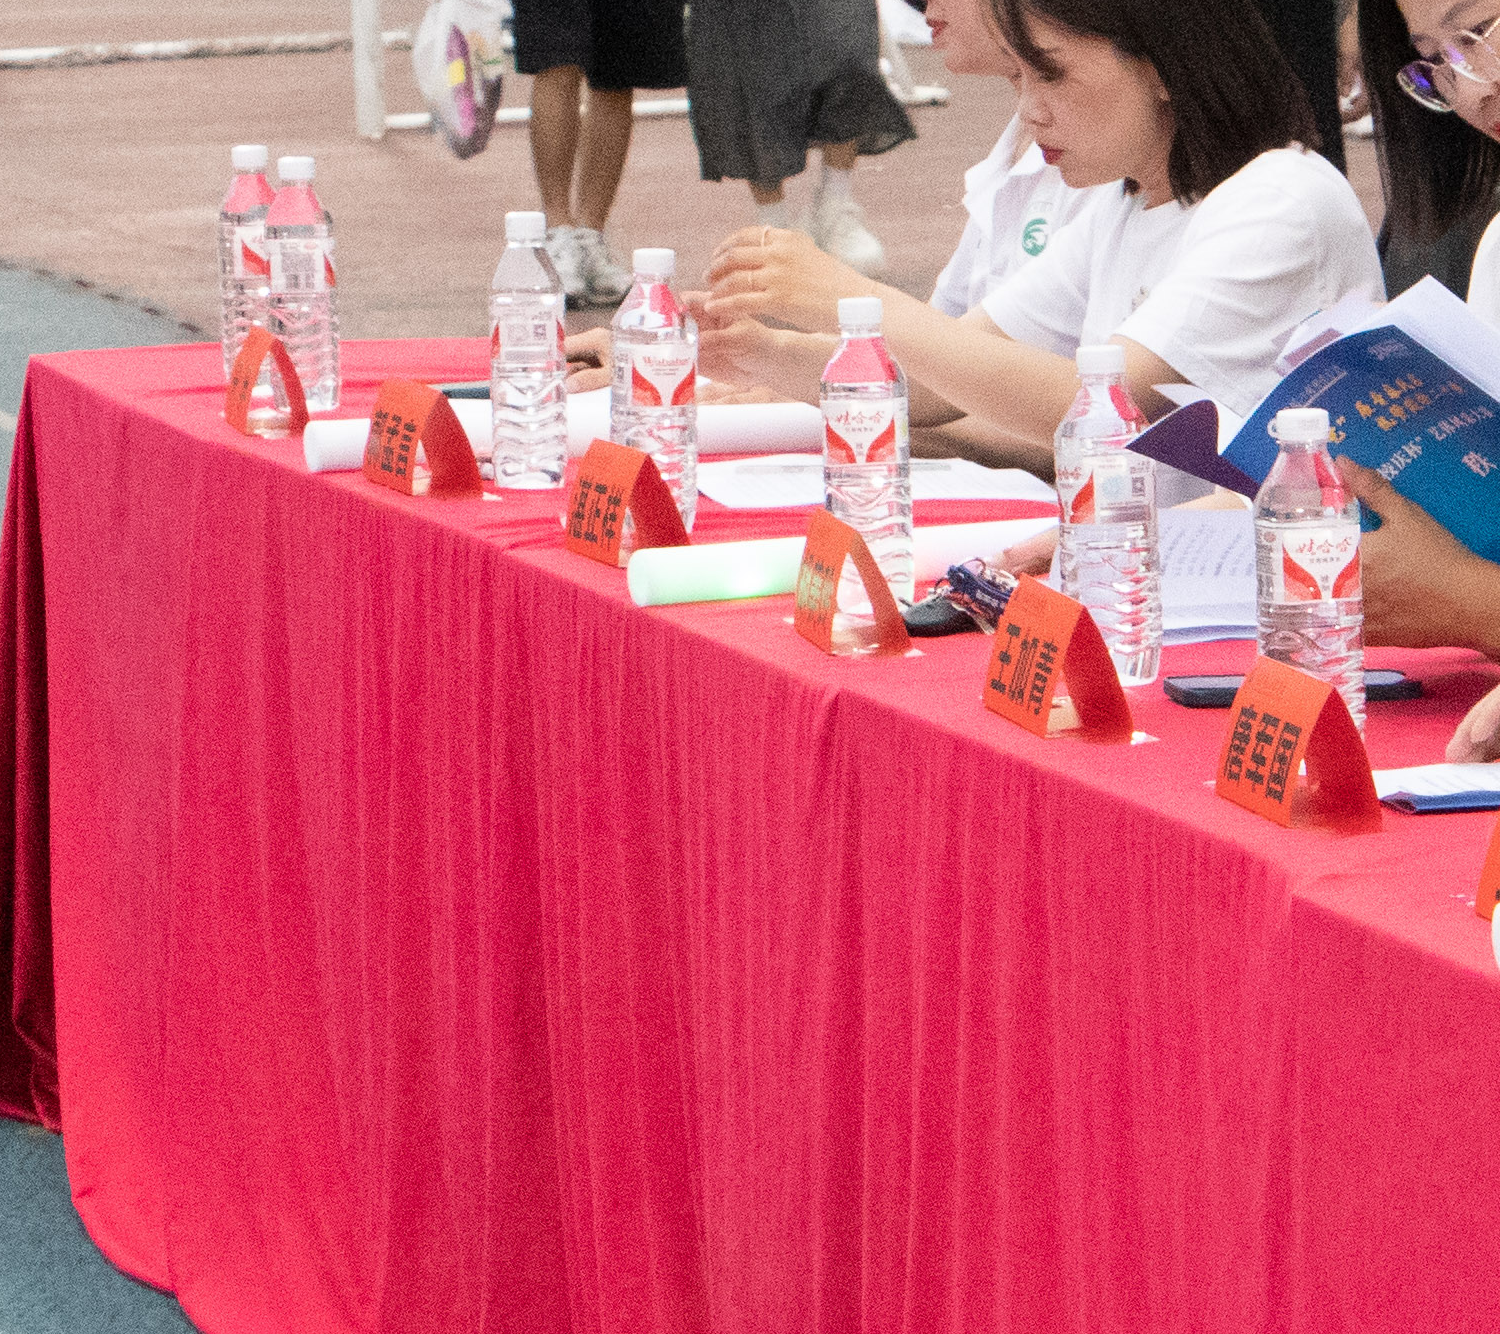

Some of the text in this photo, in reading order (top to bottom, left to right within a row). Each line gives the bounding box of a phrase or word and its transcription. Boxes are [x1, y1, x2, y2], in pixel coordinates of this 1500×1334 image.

[1295, 536, 1352, 555] 娃哈哈
[1224, 704, 1302, 803] 唐军国
